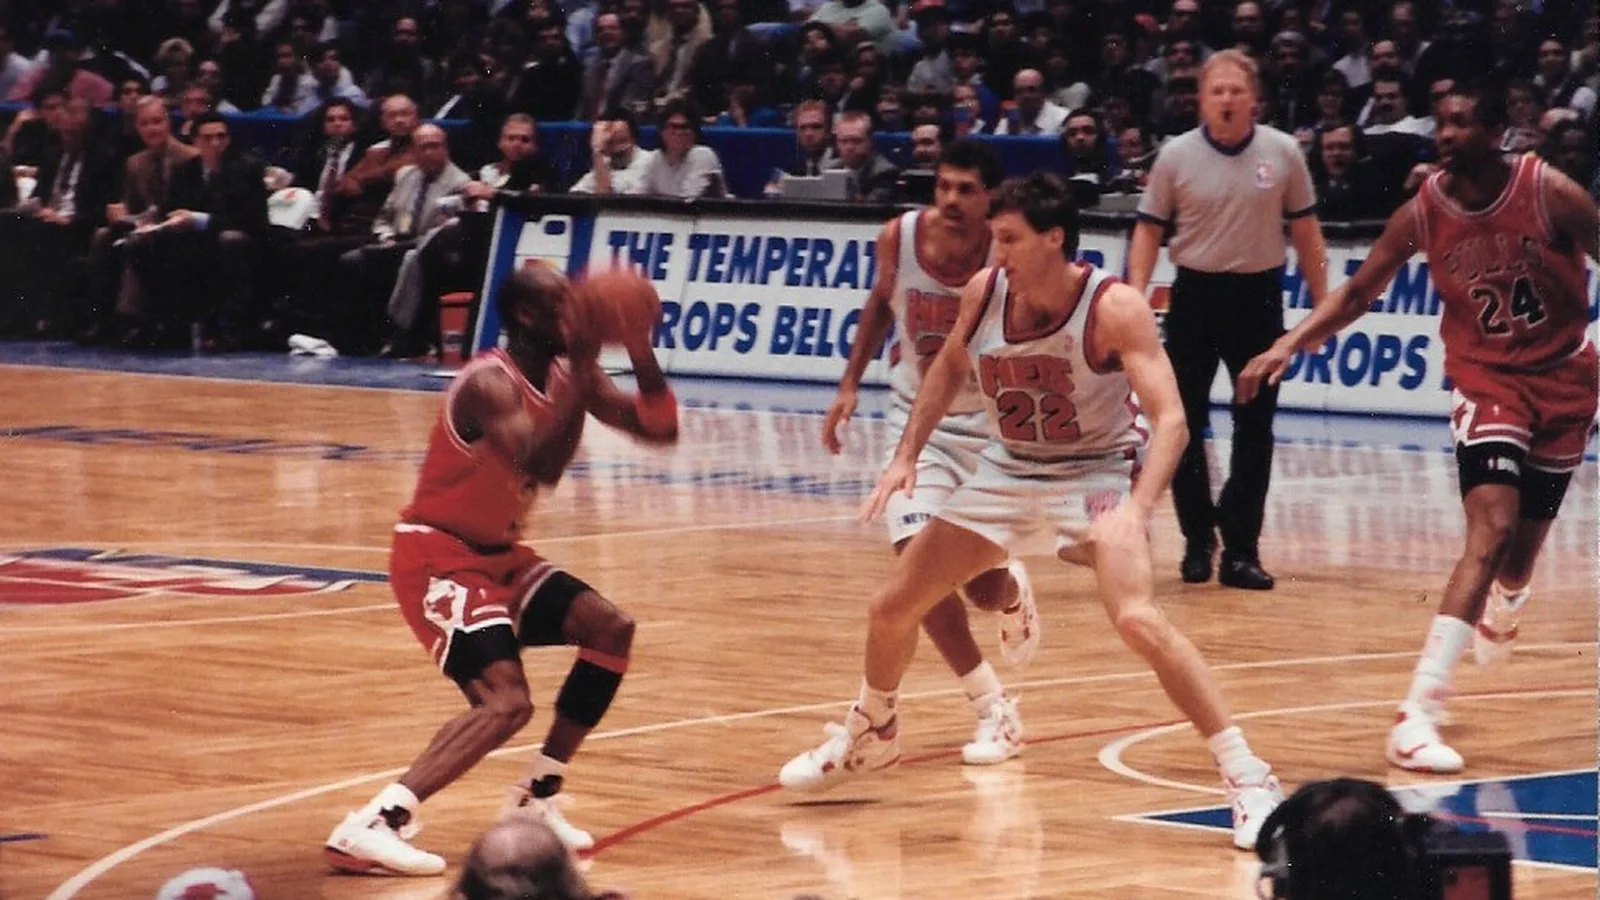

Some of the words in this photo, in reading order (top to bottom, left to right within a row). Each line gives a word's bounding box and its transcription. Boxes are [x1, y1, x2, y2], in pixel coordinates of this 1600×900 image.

[608, 231, 674, 280] THE
[687, 233, 877, 290] TEMPERAT
[651, 301, 761, 354] ROPS
[1468, 275, 1548, 337] 24
[996, 391, 1082, 442] 22
